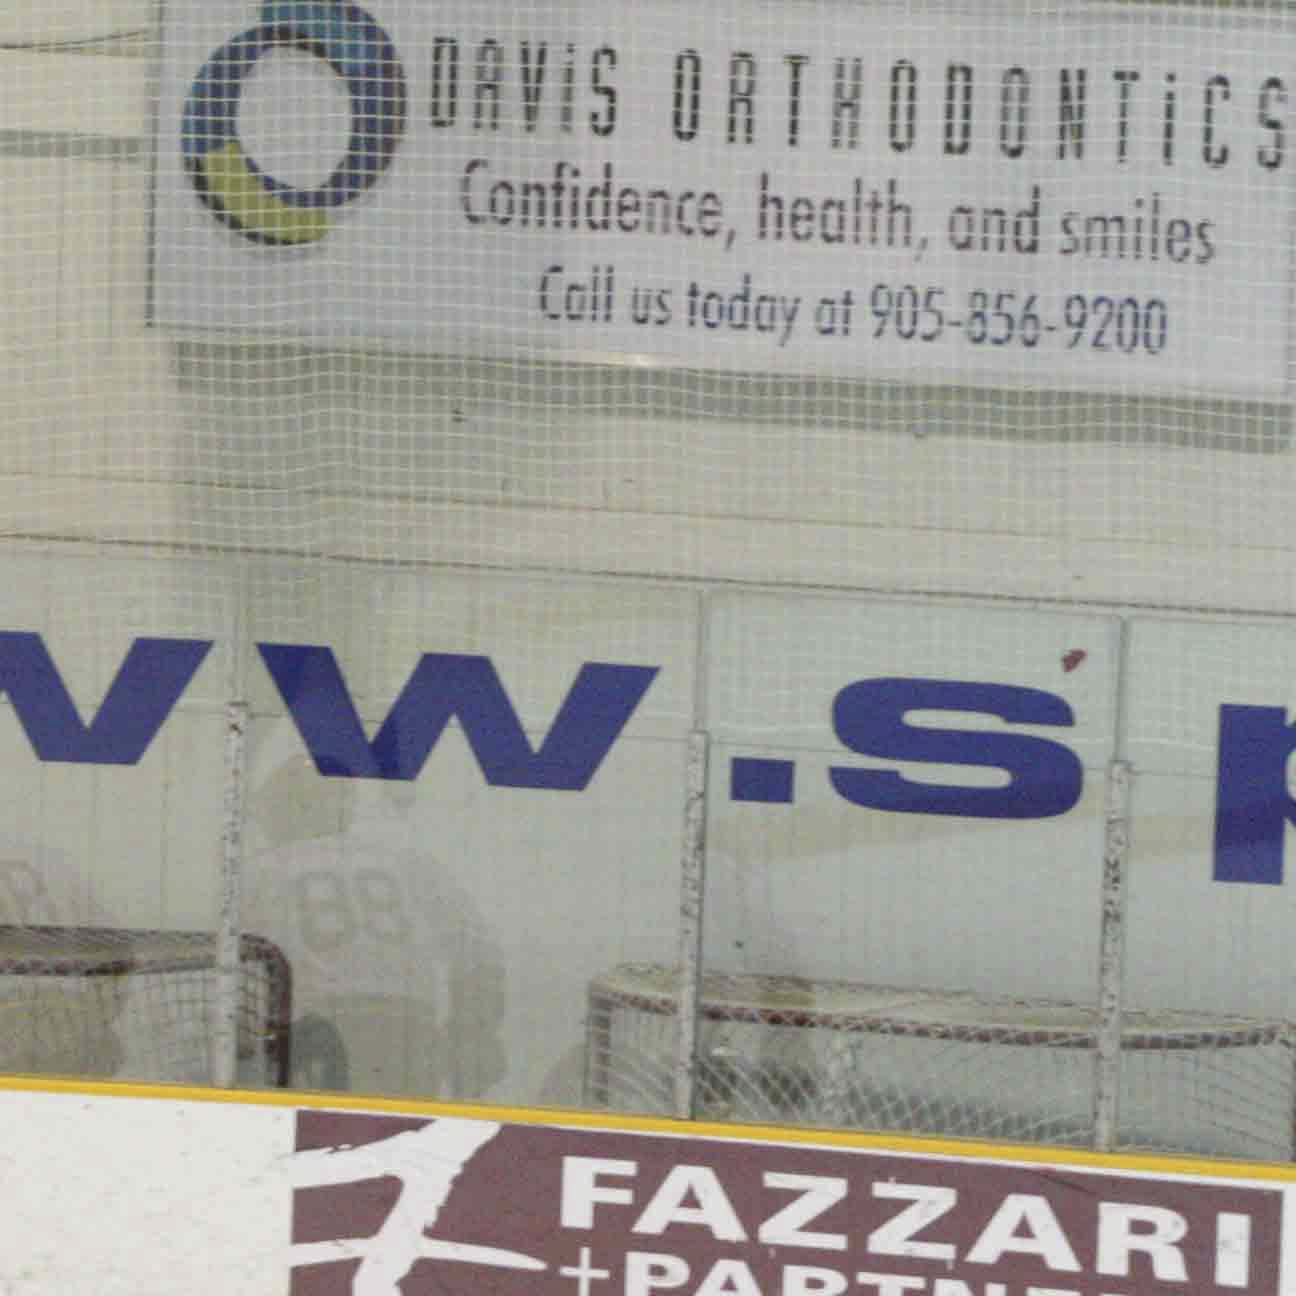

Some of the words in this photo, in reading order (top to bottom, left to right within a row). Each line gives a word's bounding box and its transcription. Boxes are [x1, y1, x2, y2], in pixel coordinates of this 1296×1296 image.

[460, 158, 736, 251] Confidence,
[758, 171, 928, 263] health,
[948, 184, 1041, 254] and
[1059, 192, 1216, 265] smiles
[539, 264, 614, 322] Call
[632, 286, 672, 325] us
[687, 272, 801, 348] today
[815, 289, 853, 336] at
[871, 284, 1168, 355] 905-856-9200
[560, 1155, 1251, 1288] FAZZARI
